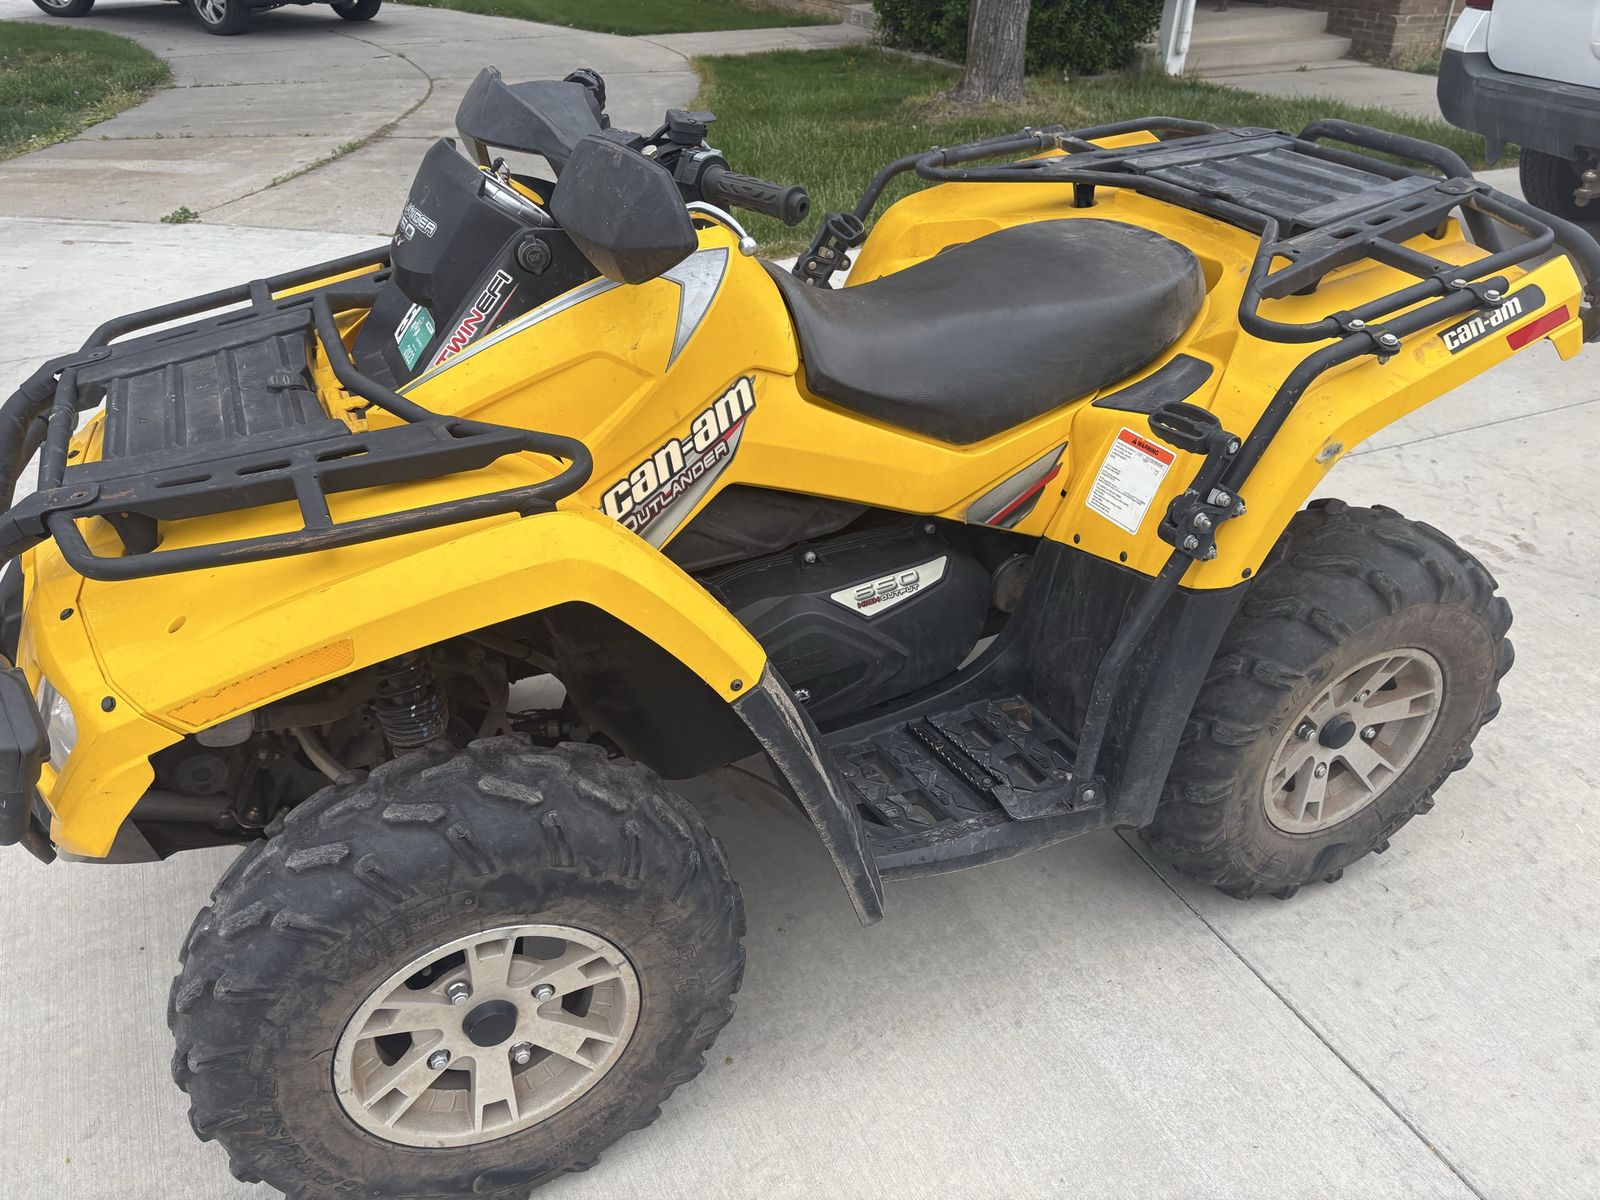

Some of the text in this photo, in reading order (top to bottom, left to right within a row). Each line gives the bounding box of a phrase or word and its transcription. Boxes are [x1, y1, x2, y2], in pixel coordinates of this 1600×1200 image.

[1443, 297, 1522, 351] can-am
[603, 377, 755, 519] can-am
[1136, 441, 1160, 456] WARNING
[623, 441, 728, 531] OUTLANDER
[854, 570, 919, 602] 650
